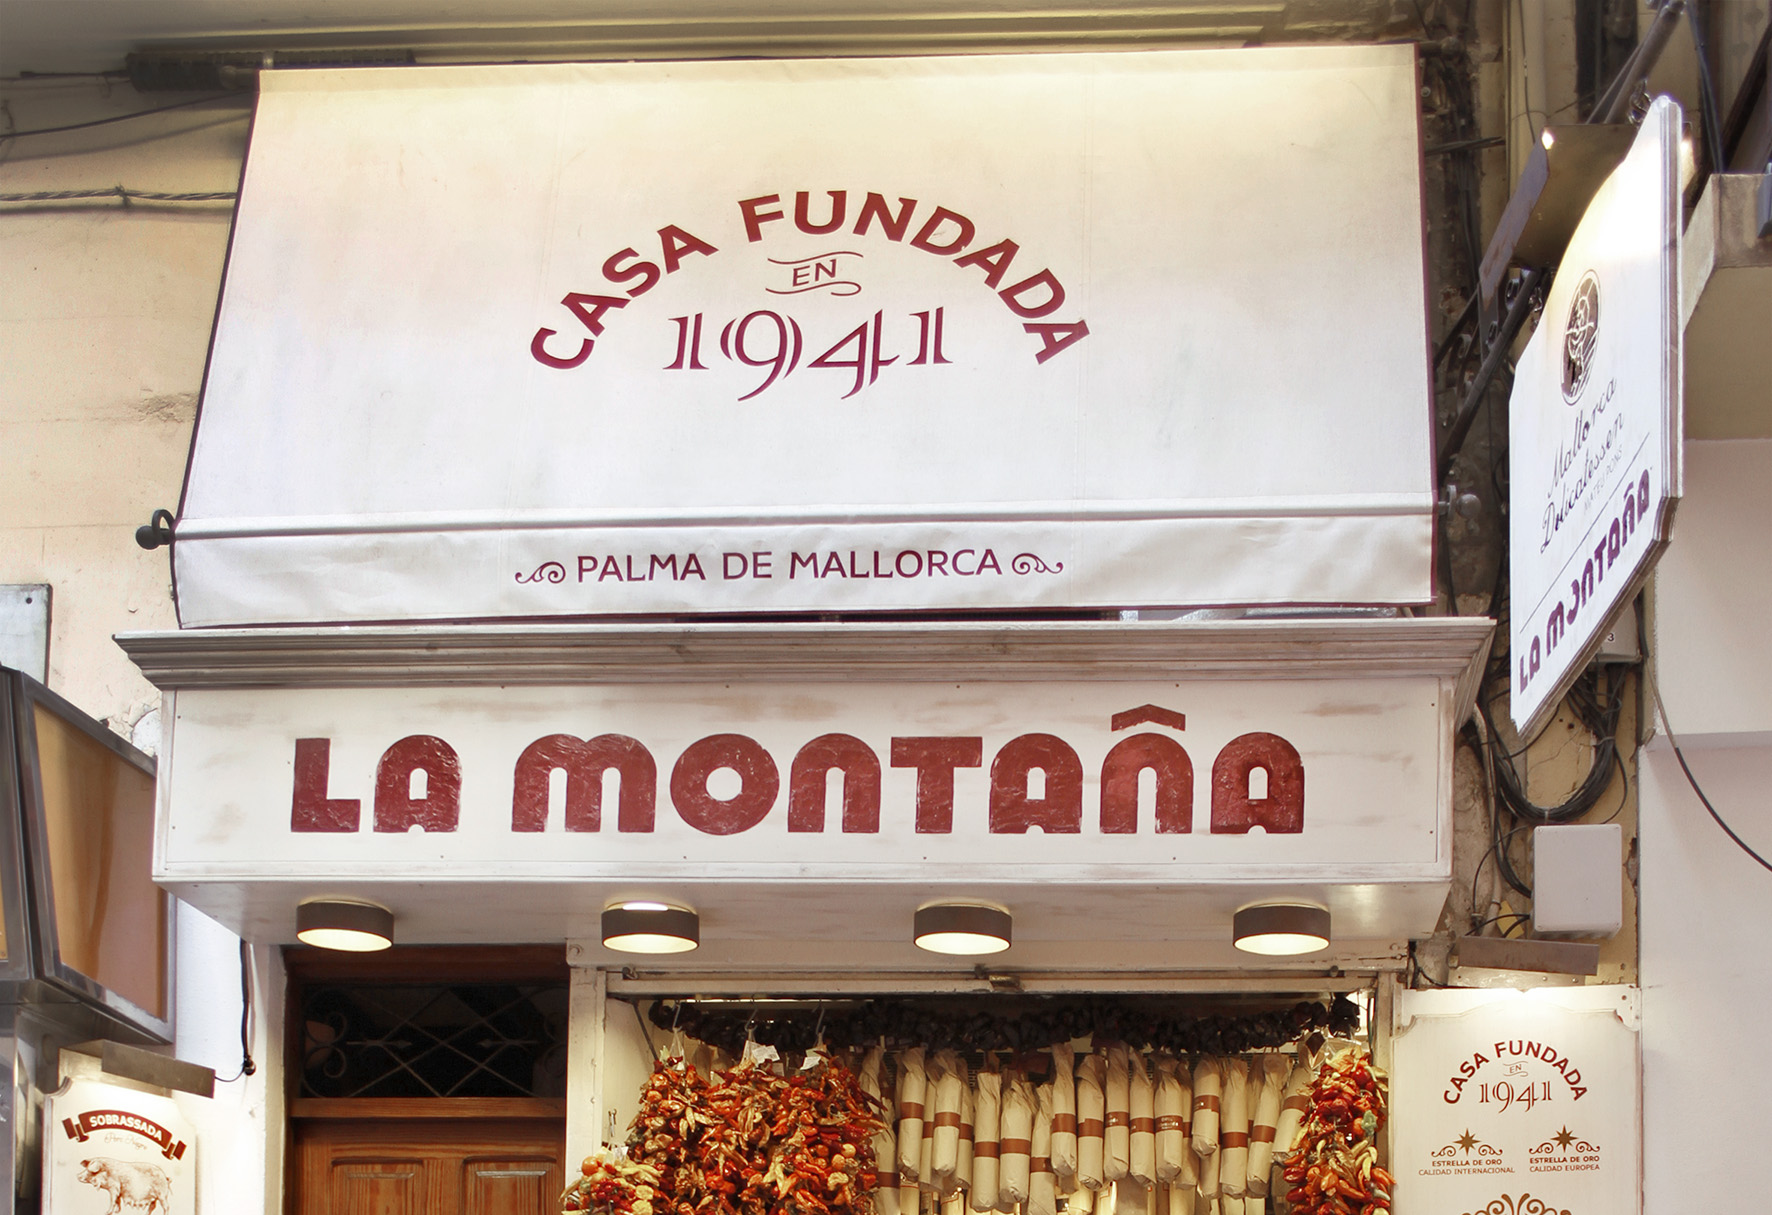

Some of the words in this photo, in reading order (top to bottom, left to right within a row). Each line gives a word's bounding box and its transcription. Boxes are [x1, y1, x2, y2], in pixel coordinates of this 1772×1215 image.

[531, 224, 719, 370] CASA
[738, 191, 1090, 365] FUNDADA
[791, 259, 838, 287] EN
[663, 306, 953, 401] 1941
[1548, 377, 1616, 498] Mallorca
[1540, 412, 1624, 554] Delicatessen
[578, 553, 706, 582] PALMA
[723, 552, 772, 579] DE
[790, 549, 1002, 579] MALLORCA
[1519, 633, 1541, 696] LA
[289, 732, 462, 835] LA
[511, 702, 1305, 836] MONTAÑA
[1443, 1051, 1489, 1104] CASA
[1494, 1040, 1588, 1101] FUNDADA
[1509, 1063, 1522, 1074] EN
[1479, 1080, 1553, 1113] 1941
[89, 1115, 162, 1142] SOBRASSADA
[1419, 1168, 1452, 1176] CALIDAD
[1455, 1167, 1515, 1175] INTERNACIONAL
[1485, 1158, 1502, 1166] ORO
[1530, 1156, 1567, 1164] ESTRELLA
[1583, 1155, 1600, 1163] ORO
[1530, 1165, 1562, 1173] CALIDAD
